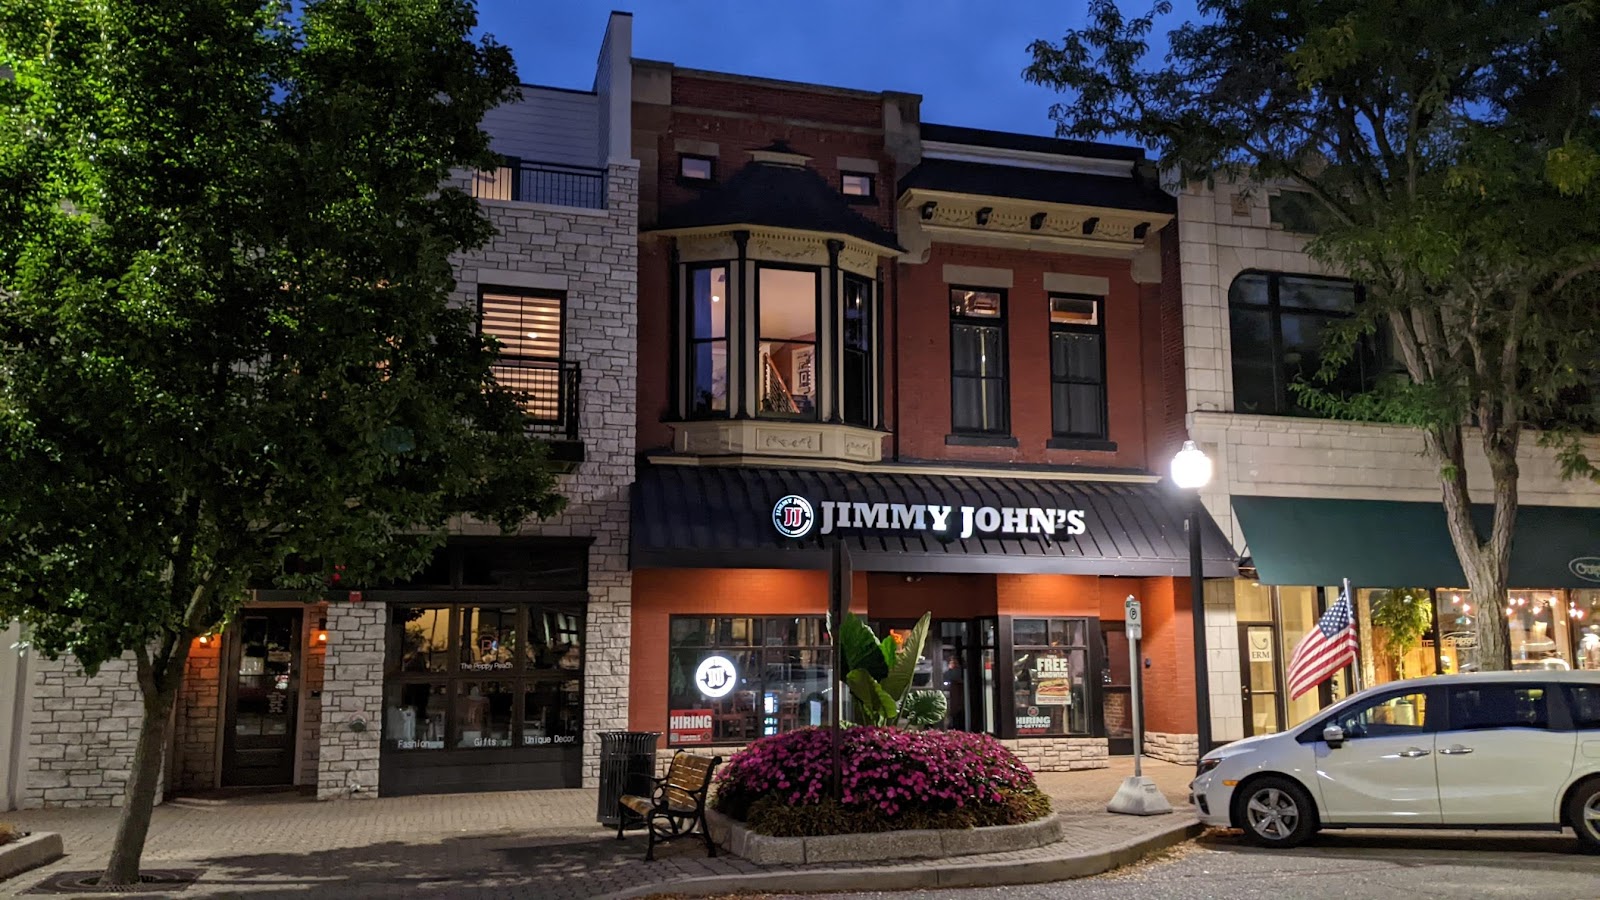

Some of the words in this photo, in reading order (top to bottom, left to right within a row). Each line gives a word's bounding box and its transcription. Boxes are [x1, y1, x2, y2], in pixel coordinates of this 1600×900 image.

[784, 506, 803, 527] JJ
[820, 501, 951, 535] JIMMY
[960, 506, 1086, 539] JOHN'S
[1251, 651, 1270, 659] ERM
[461, 662, 473, 670] The
[474, 662, 493, 671] Poppy
[494, 661, 513, 669] Peach
[1037, 658, 1069, 672] FREE
[670, 715, 712, 729] HIRING
[1015, 716, 1051, 725] HIRING
[397, 739, 430, 749] Fashion
[473, 737, 497, 747] Gifts
[524, 735, 551, 745] Unique
[553, 734, 575, 744] Decor
